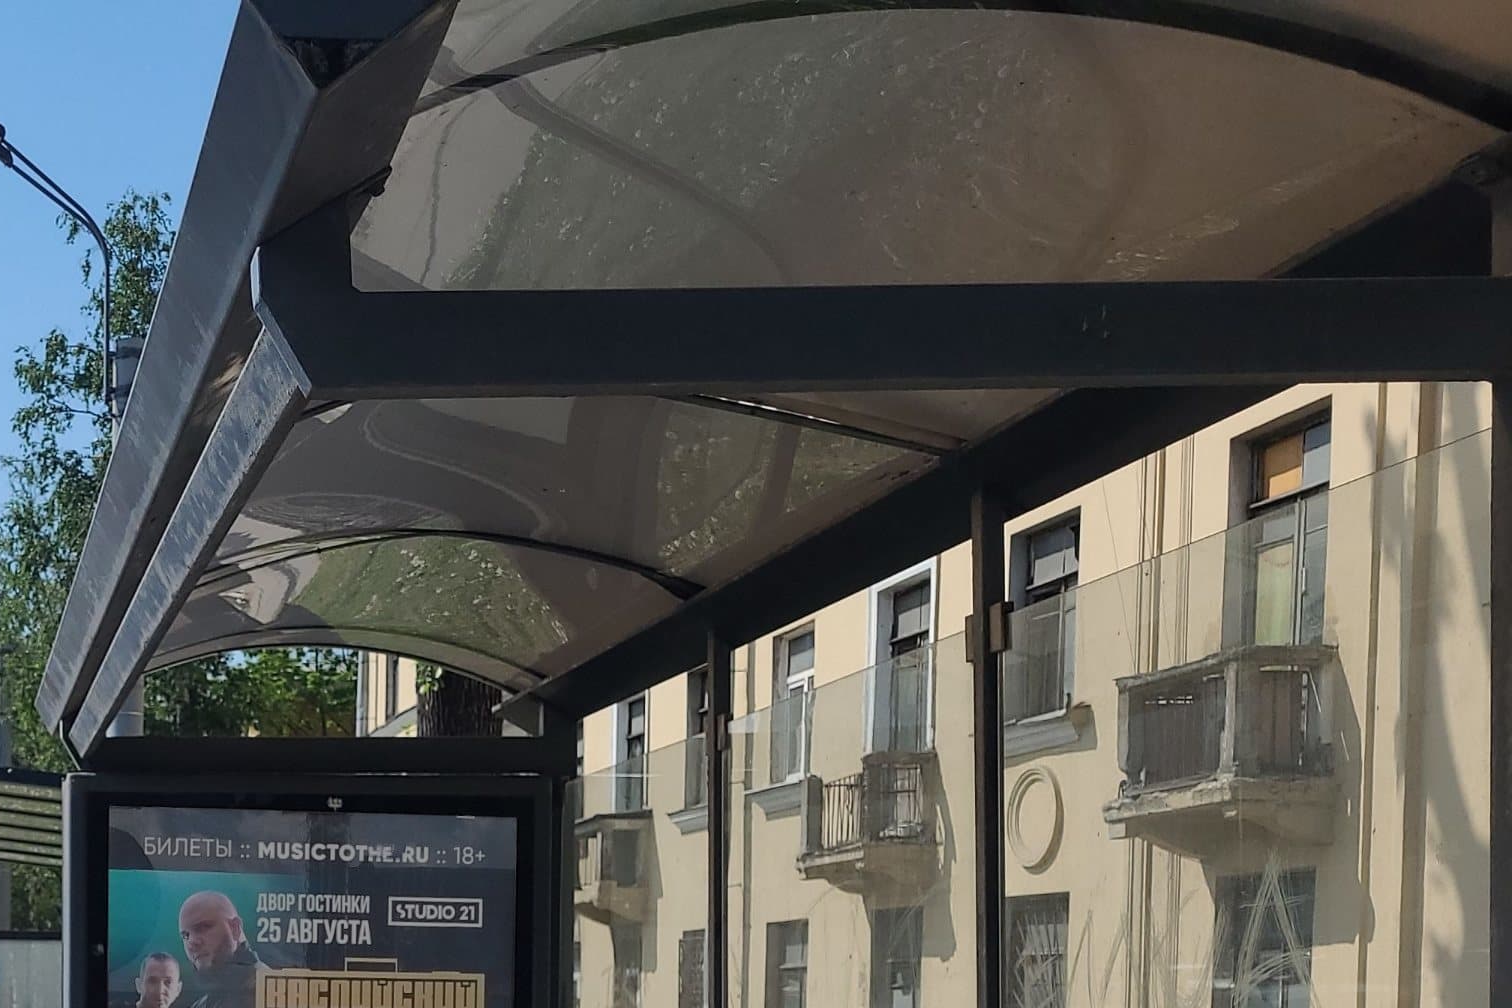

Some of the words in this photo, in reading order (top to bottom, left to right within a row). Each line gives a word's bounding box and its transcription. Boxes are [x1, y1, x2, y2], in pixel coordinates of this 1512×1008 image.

[143, 836, 233, 858] БИЛЕТЫ
[257, 841, 429, 863] MUSICTOTHE.RU
[453, 846, 486, 865] 18+
[256, 892, 296, 913] ДВОР
[298, 893, 371, 914] ГОСТИНКИ
[396, 903, 456, 921] STUDIO
[459, 905, 476, 921] 21
[256, 917, 282, 943] 25
[286, 918, 372, 945] АВГУСТА
